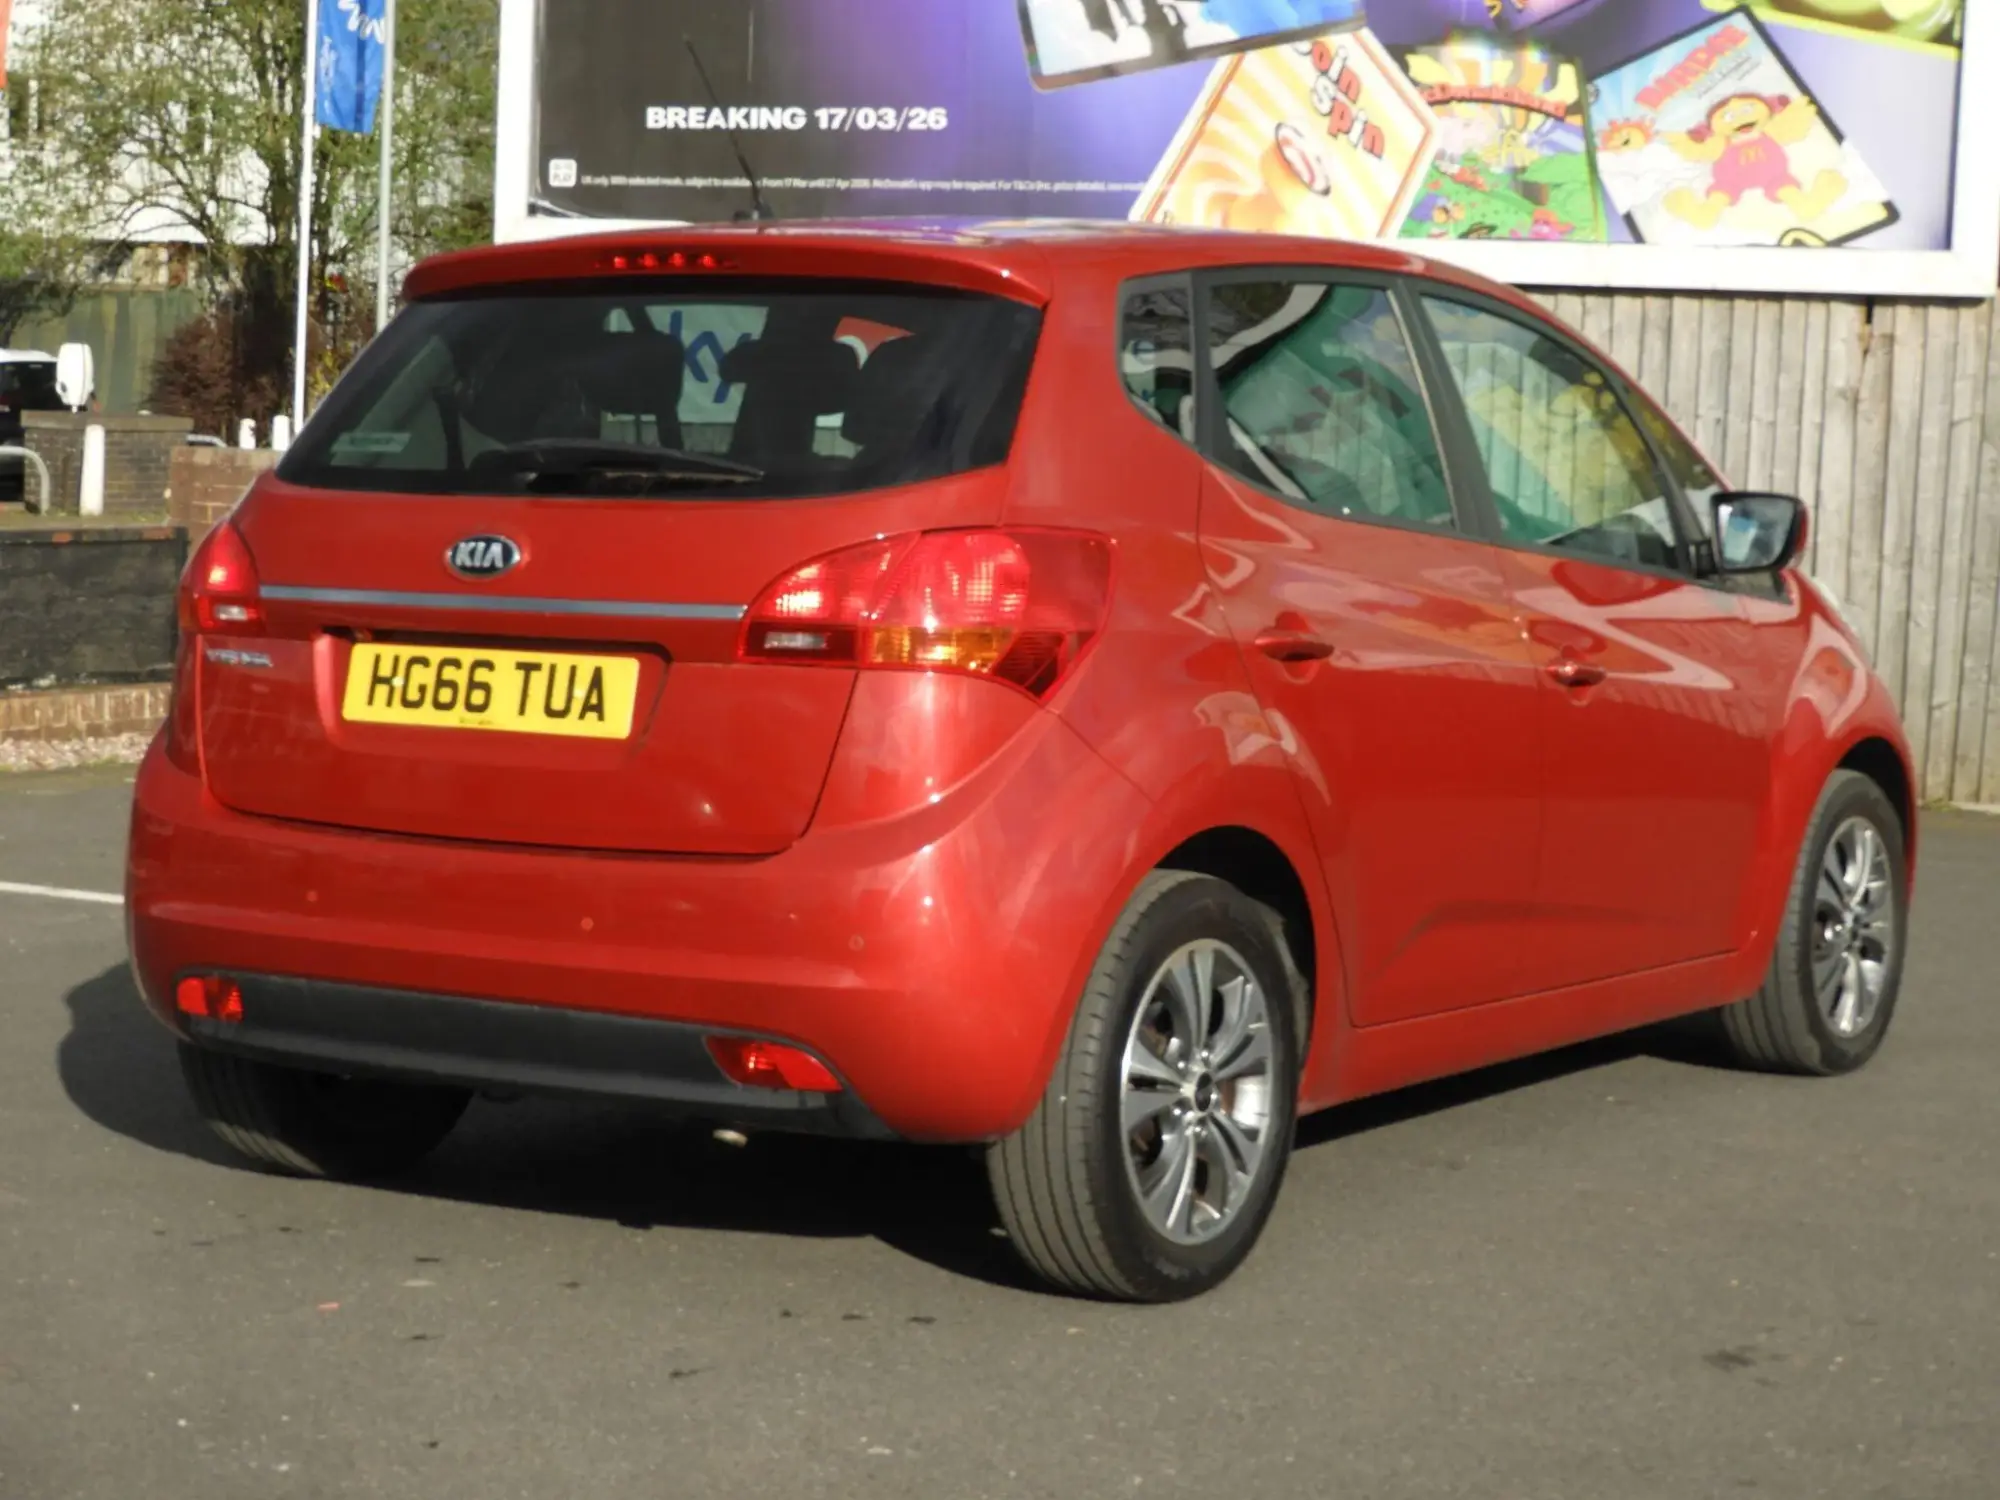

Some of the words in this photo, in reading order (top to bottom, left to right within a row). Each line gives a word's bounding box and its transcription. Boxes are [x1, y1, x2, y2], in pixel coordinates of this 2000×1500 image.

[1420, 81, 1568, 121] cDonaldland
[645, 105, 808, 130] BREAKING
[814, 107, 949, 132] 17/03/26
[455, 541, 504, 568] KIA
[366, 653, 495, 713] HG66
[514, 660, 605, 722] TUA
